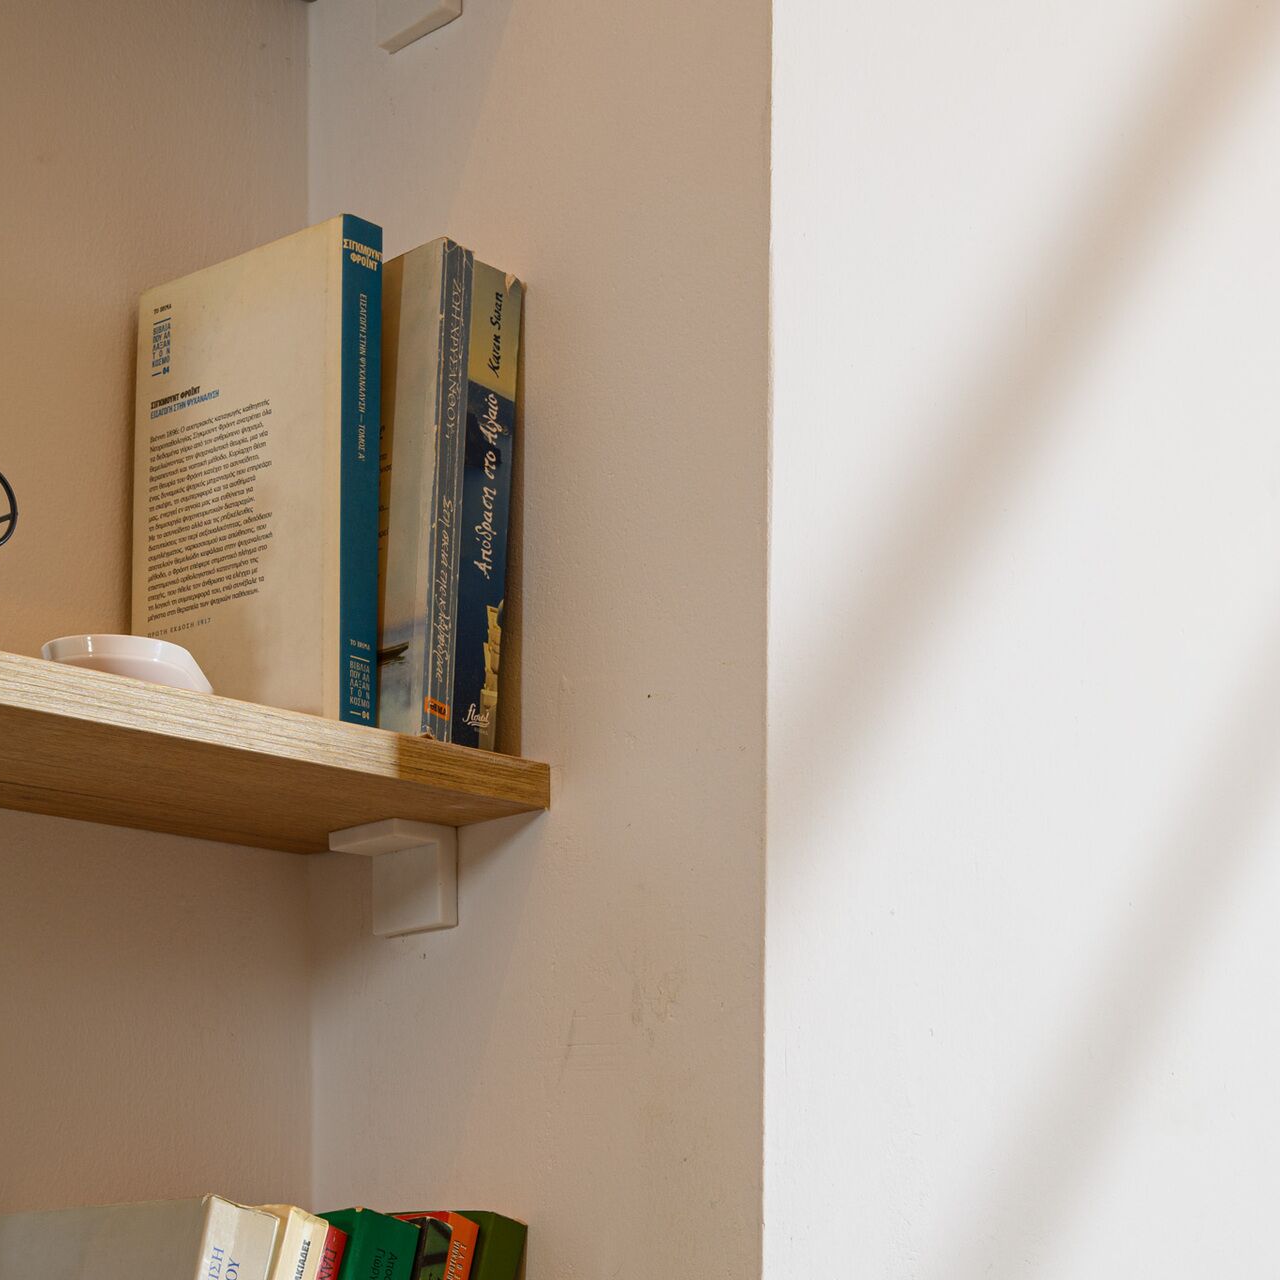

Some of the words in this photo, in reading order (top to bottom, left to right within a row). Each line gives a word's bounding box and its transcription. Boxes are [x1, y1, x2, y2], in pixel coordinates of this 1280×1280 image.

[350, 252, 377, 271] ΦΡΟΪΝΤ
[489, 291, 503, 332] Swan
[487, 335, 501, 378] Karen
[474, 486, 497, 580] Απόδραση
